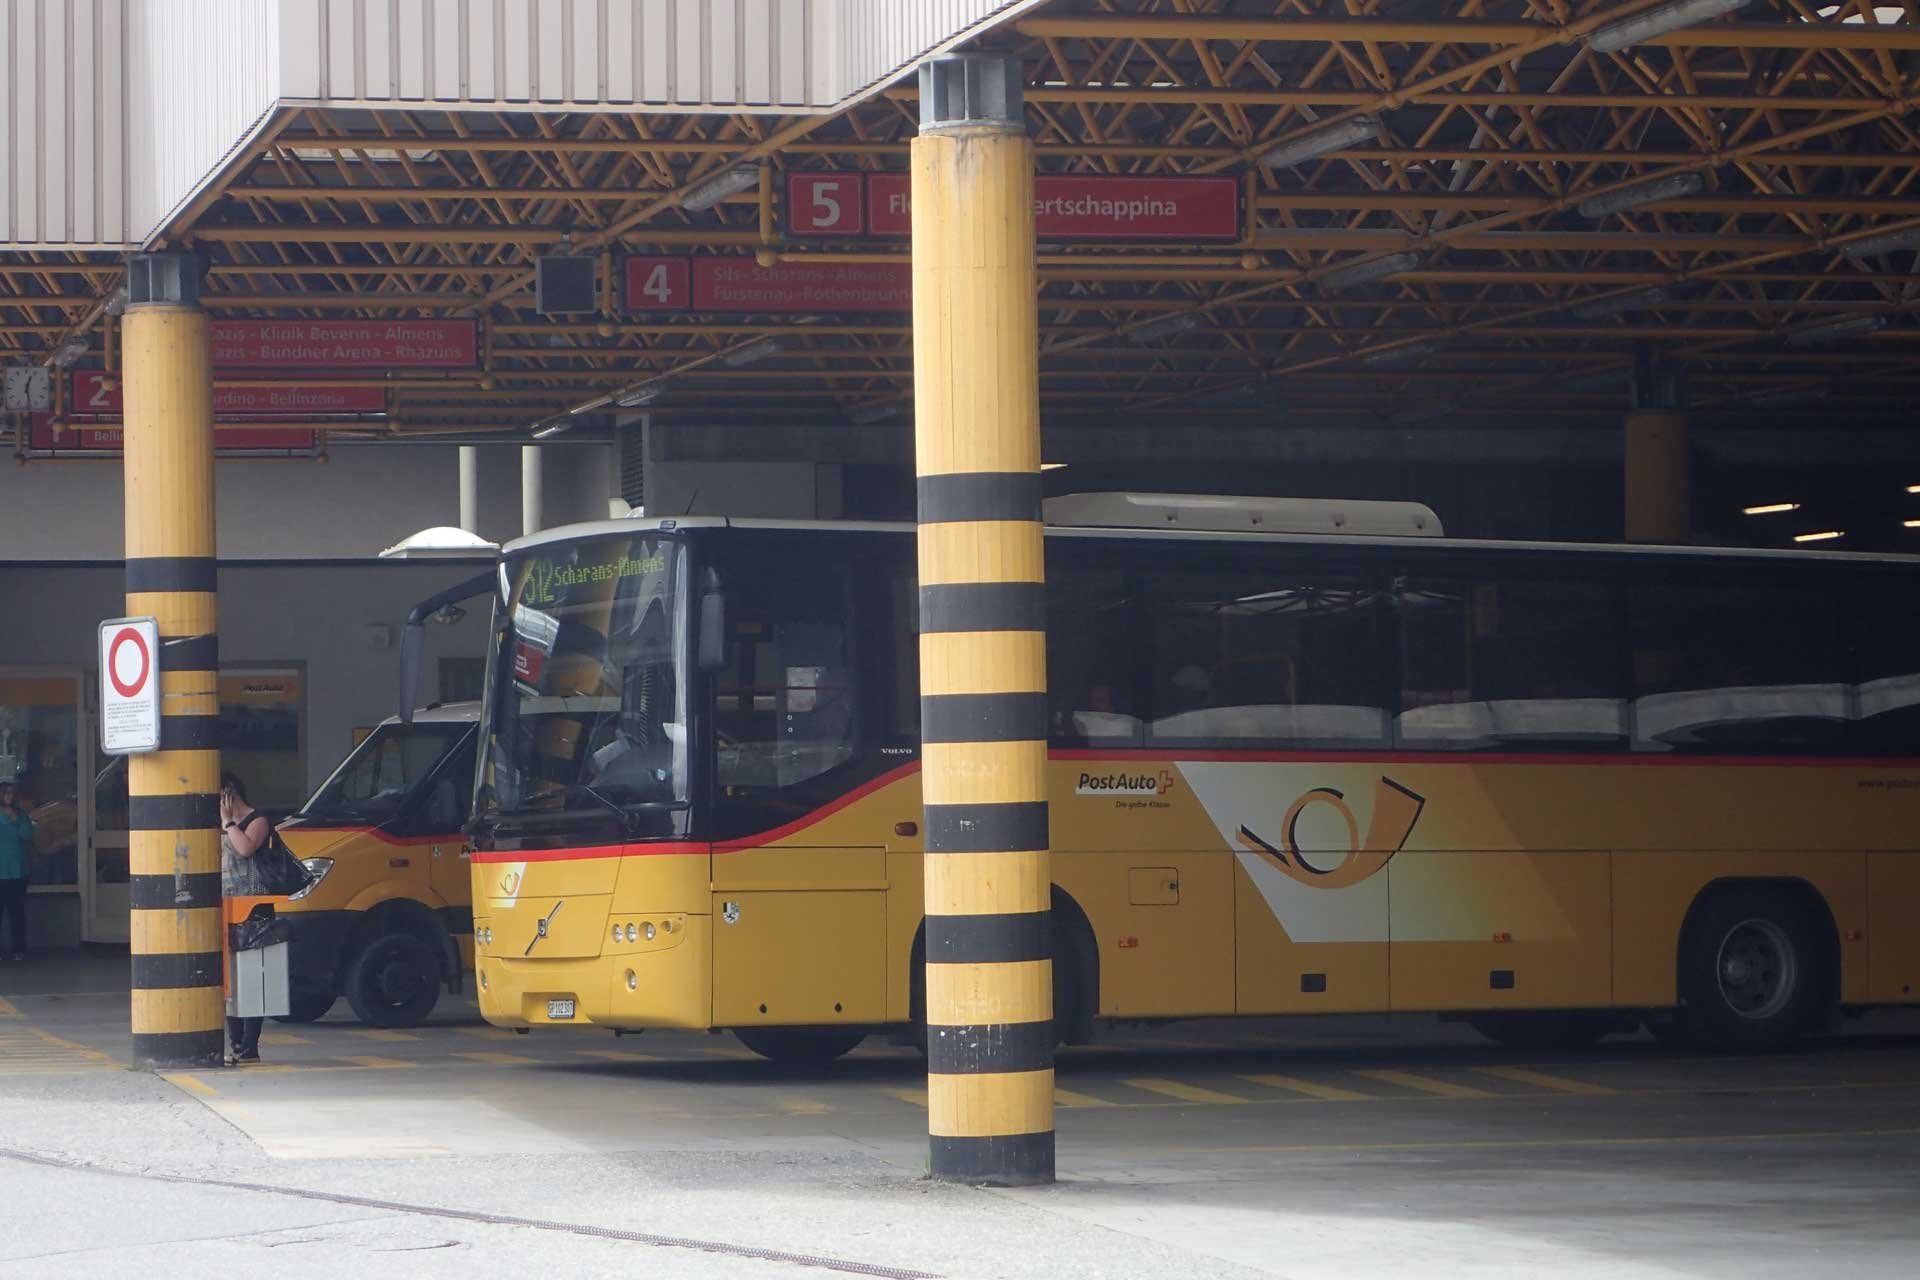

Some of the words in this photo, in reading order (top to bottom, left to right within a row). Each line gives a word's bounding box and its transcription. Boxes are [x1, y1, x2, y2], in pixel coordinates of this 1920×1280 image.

[811, 181, 841, 227] 5
[643, 264, 672, 304] 4
[260, 325, 304, 340] Klinik
[333, 344, 382, 360] Arena
[89, 375, 112, 406] 2
[1078, 772, 1157, 790] PostAuto
